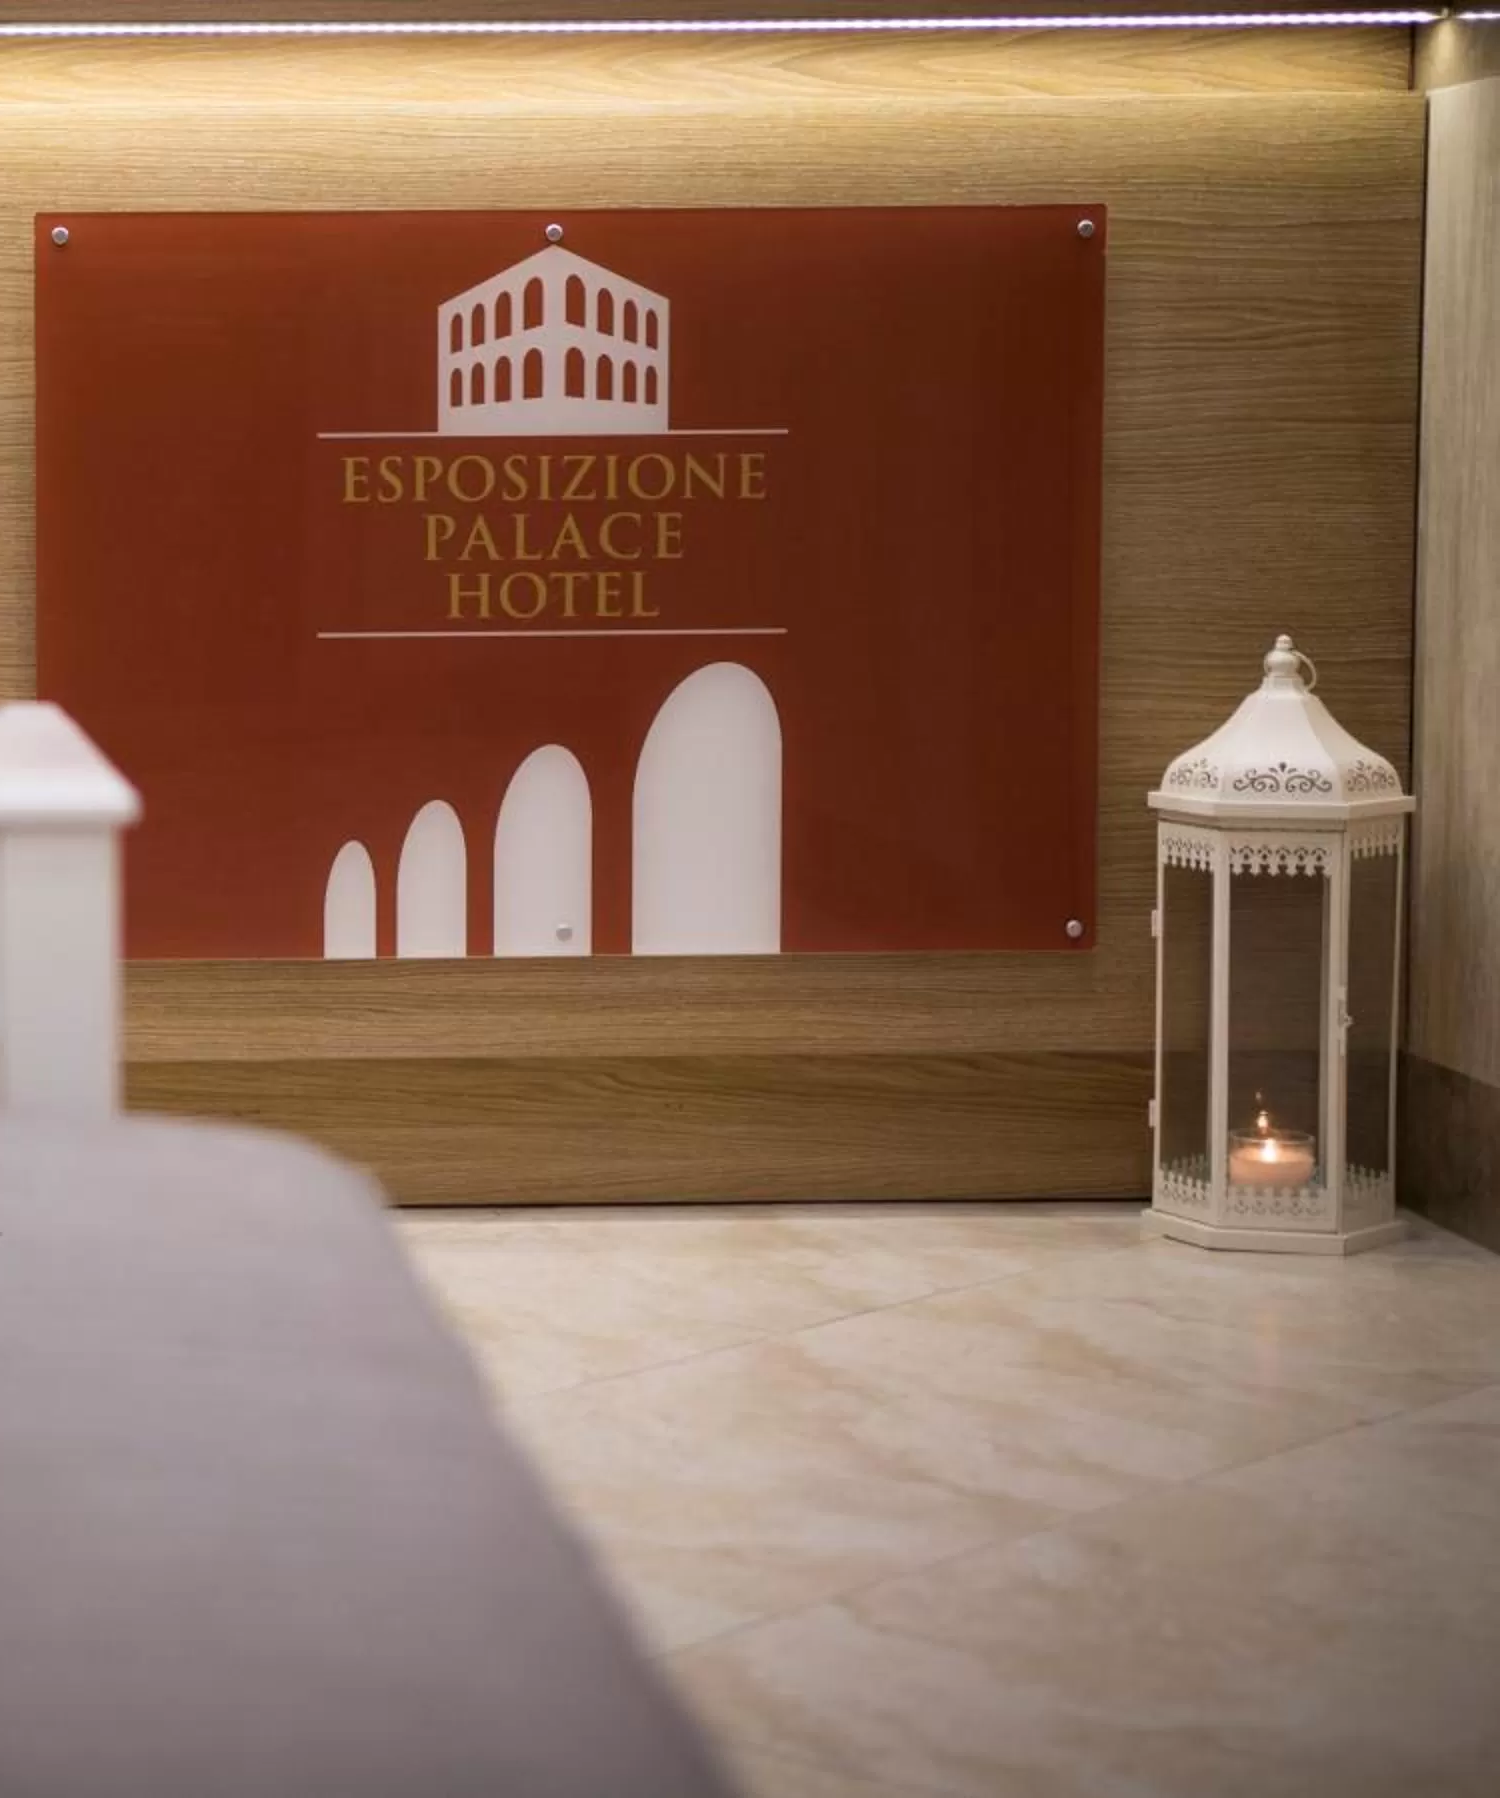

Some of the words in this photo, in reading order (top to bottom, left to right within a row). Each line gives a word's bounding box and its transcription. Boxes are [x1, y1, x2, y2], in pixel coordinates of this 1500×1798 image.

[341, 453, 766, 502] ESPOSIZIONE
[423, 511, 685, 561] PALACE
[445, 571, 661, 620] HOTEL
